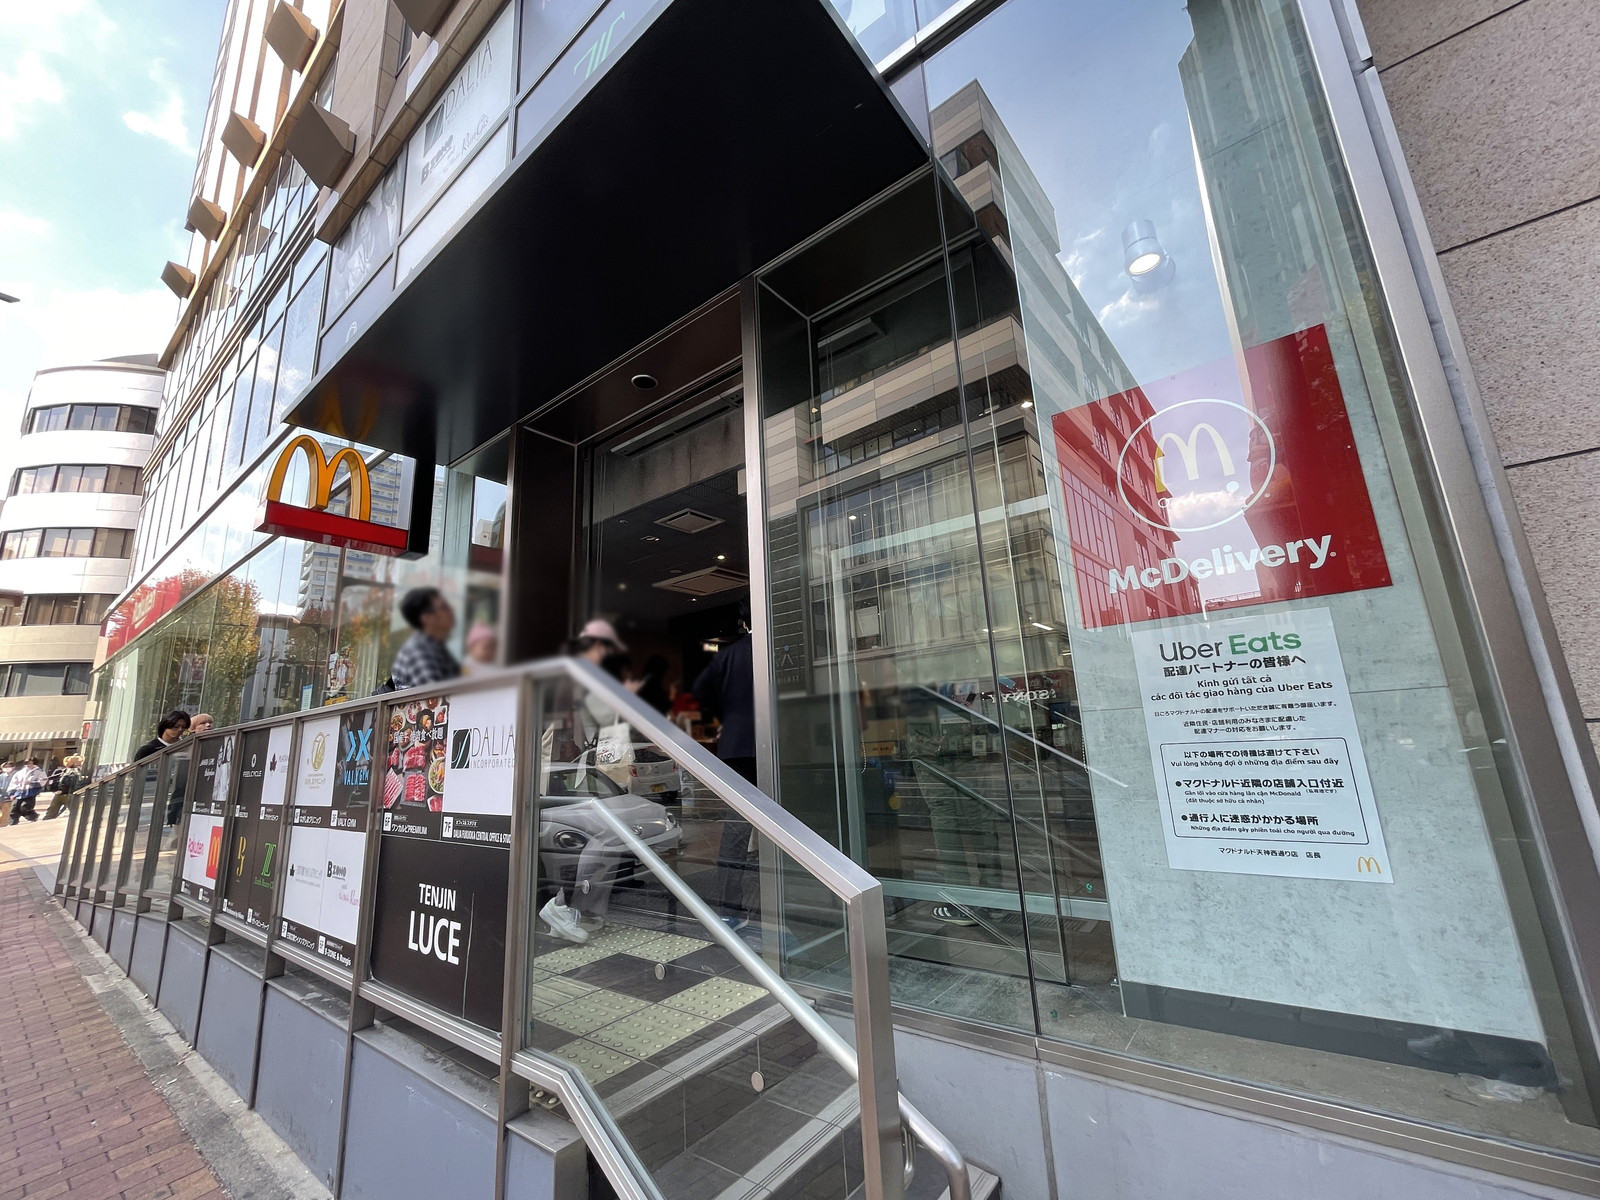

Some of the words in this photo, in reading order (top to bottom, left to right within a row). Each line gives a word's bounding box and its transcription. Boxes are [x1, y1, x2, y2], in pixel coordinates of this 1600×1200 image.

[445, 39, 492, 120] DALIA
[1159, 641, 1223, 662] Uber
[1228, 631, 1302, 655] Eats
[1163, 655, 1306, 677] 配達パートナーの皆様へ
[1151, 693, 1167, 701] các
[1186, 690, 1201, 698] tác
[1203, 689, 1225, 699] giao
[1227, 687, 1253, 696] hàng
[1256, 684, 1275, 693] của
[1277, 683, 1305, 692] Uber
[1307, 681, 1333, 690] Eats
[1197, 679, 1220, 688] Kính
[471, 724, 515, 757] DALIA
[1184, 748, 1320, 758] 以下の場所での待機は避けて下さい
[343, 769, 360, 786] VALX
[1182, 778, 1345, 788] マクドナルド近隣の店舗入口付近
[1189, 813, 1319, 826] 通行人に迷惑がかかる場所
[1218, 847, 1299, 858] マクドナルド天神西通り店
[1305, 851, 1321, 859] 店長
[418, 882, 457, 912] TENJIN
[408, 910, 462, 966] LUCE
